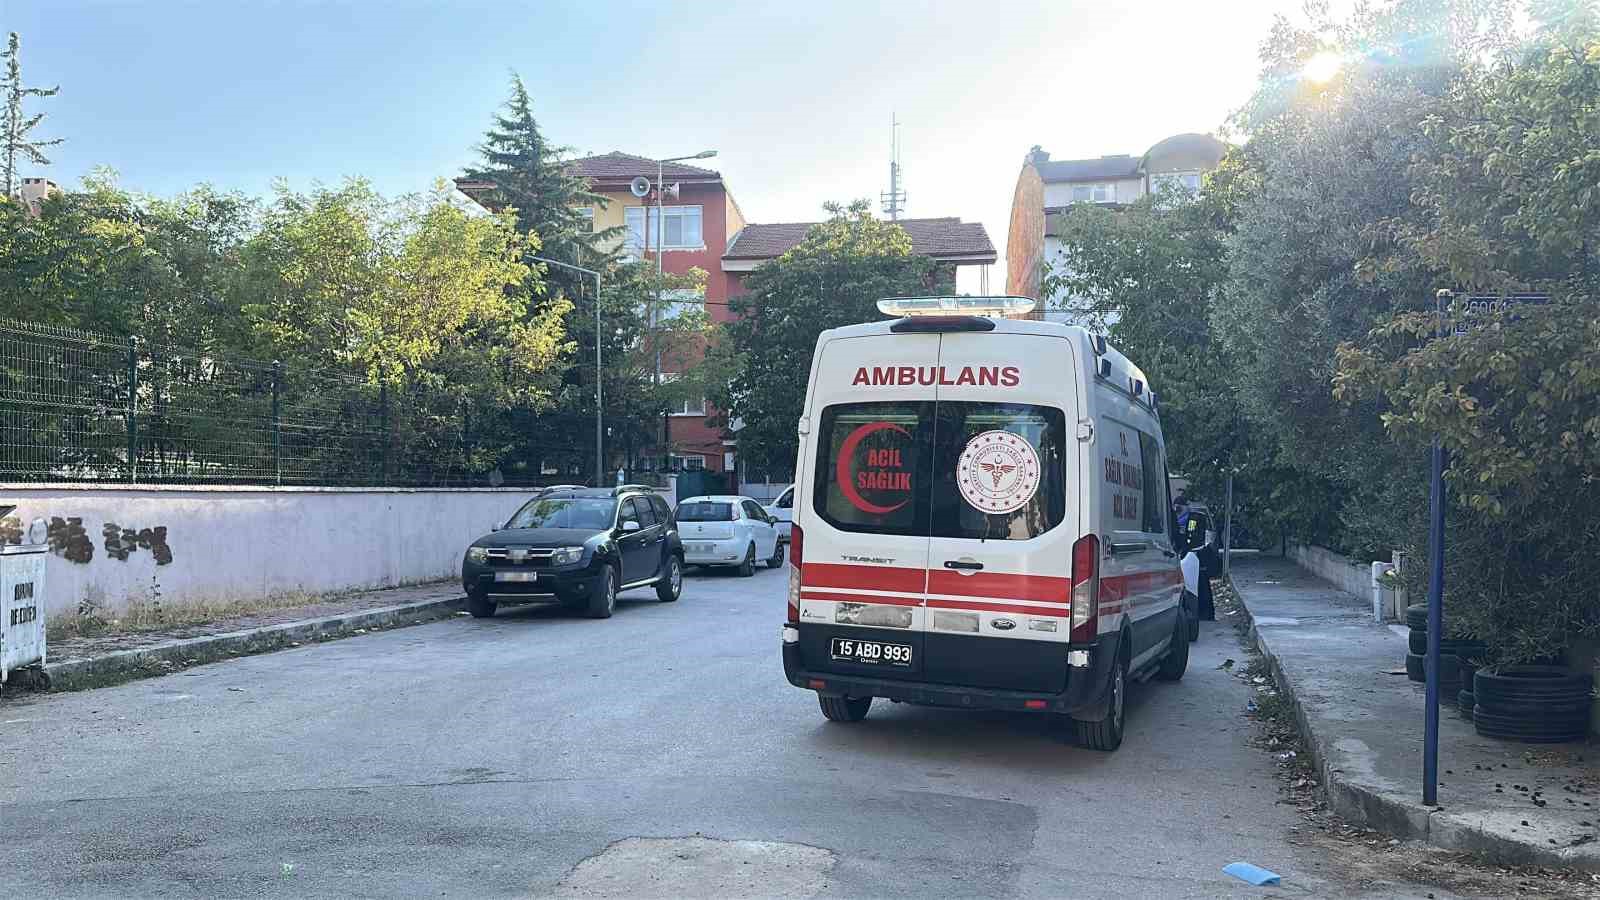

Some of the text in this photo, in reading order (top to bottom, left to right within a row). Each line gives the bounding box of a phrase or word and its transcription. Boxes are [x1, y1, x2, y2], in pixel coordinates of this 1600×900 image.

[852, 366, 1020, 387] AMBULANS
[839, 641, 910, 661] 15 ABD 993
